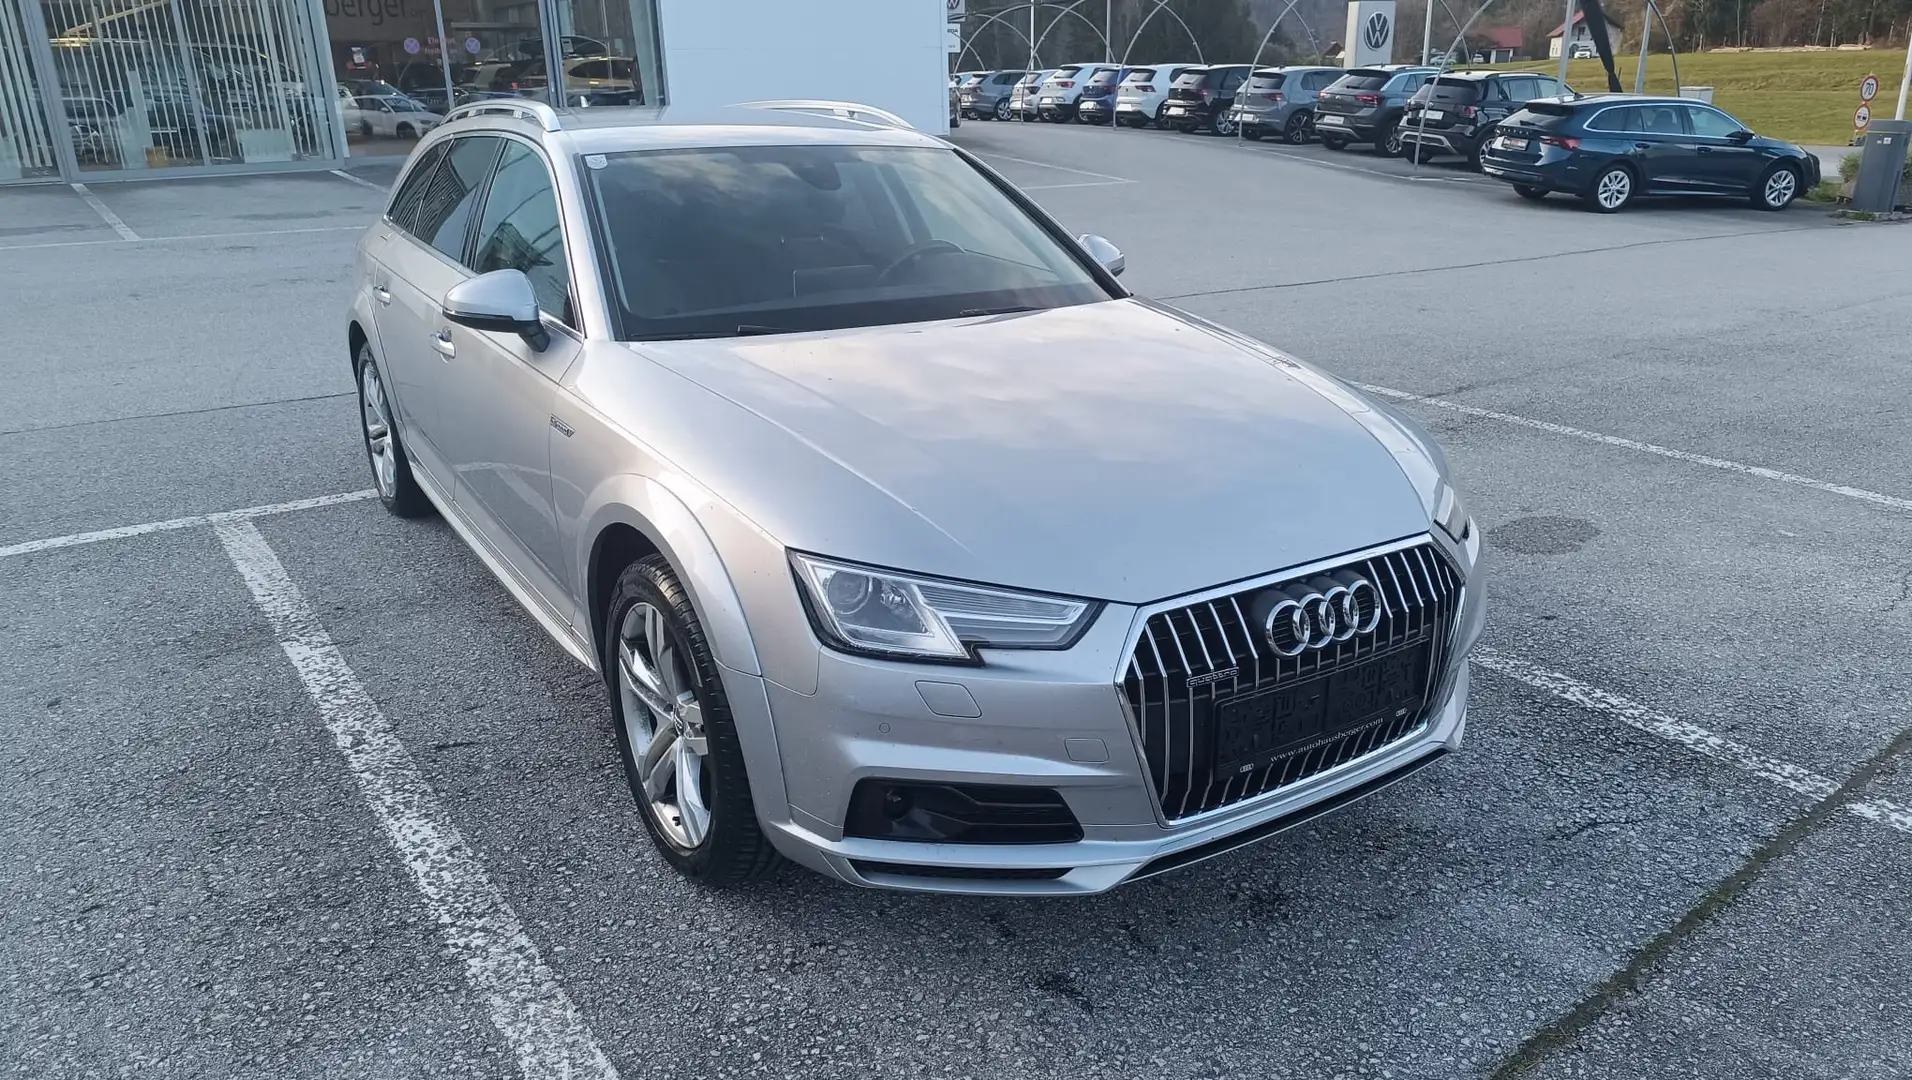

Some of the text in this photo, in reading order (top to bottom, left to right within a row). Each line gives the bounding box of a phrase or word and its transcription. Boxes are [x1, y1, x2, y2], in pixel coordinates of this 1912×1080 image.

[1863, 81, 1875, 97] 70
[1189, 669, 1238, 687] quattro
[1270, 717, 1384, 763] www.autohausberger.com
